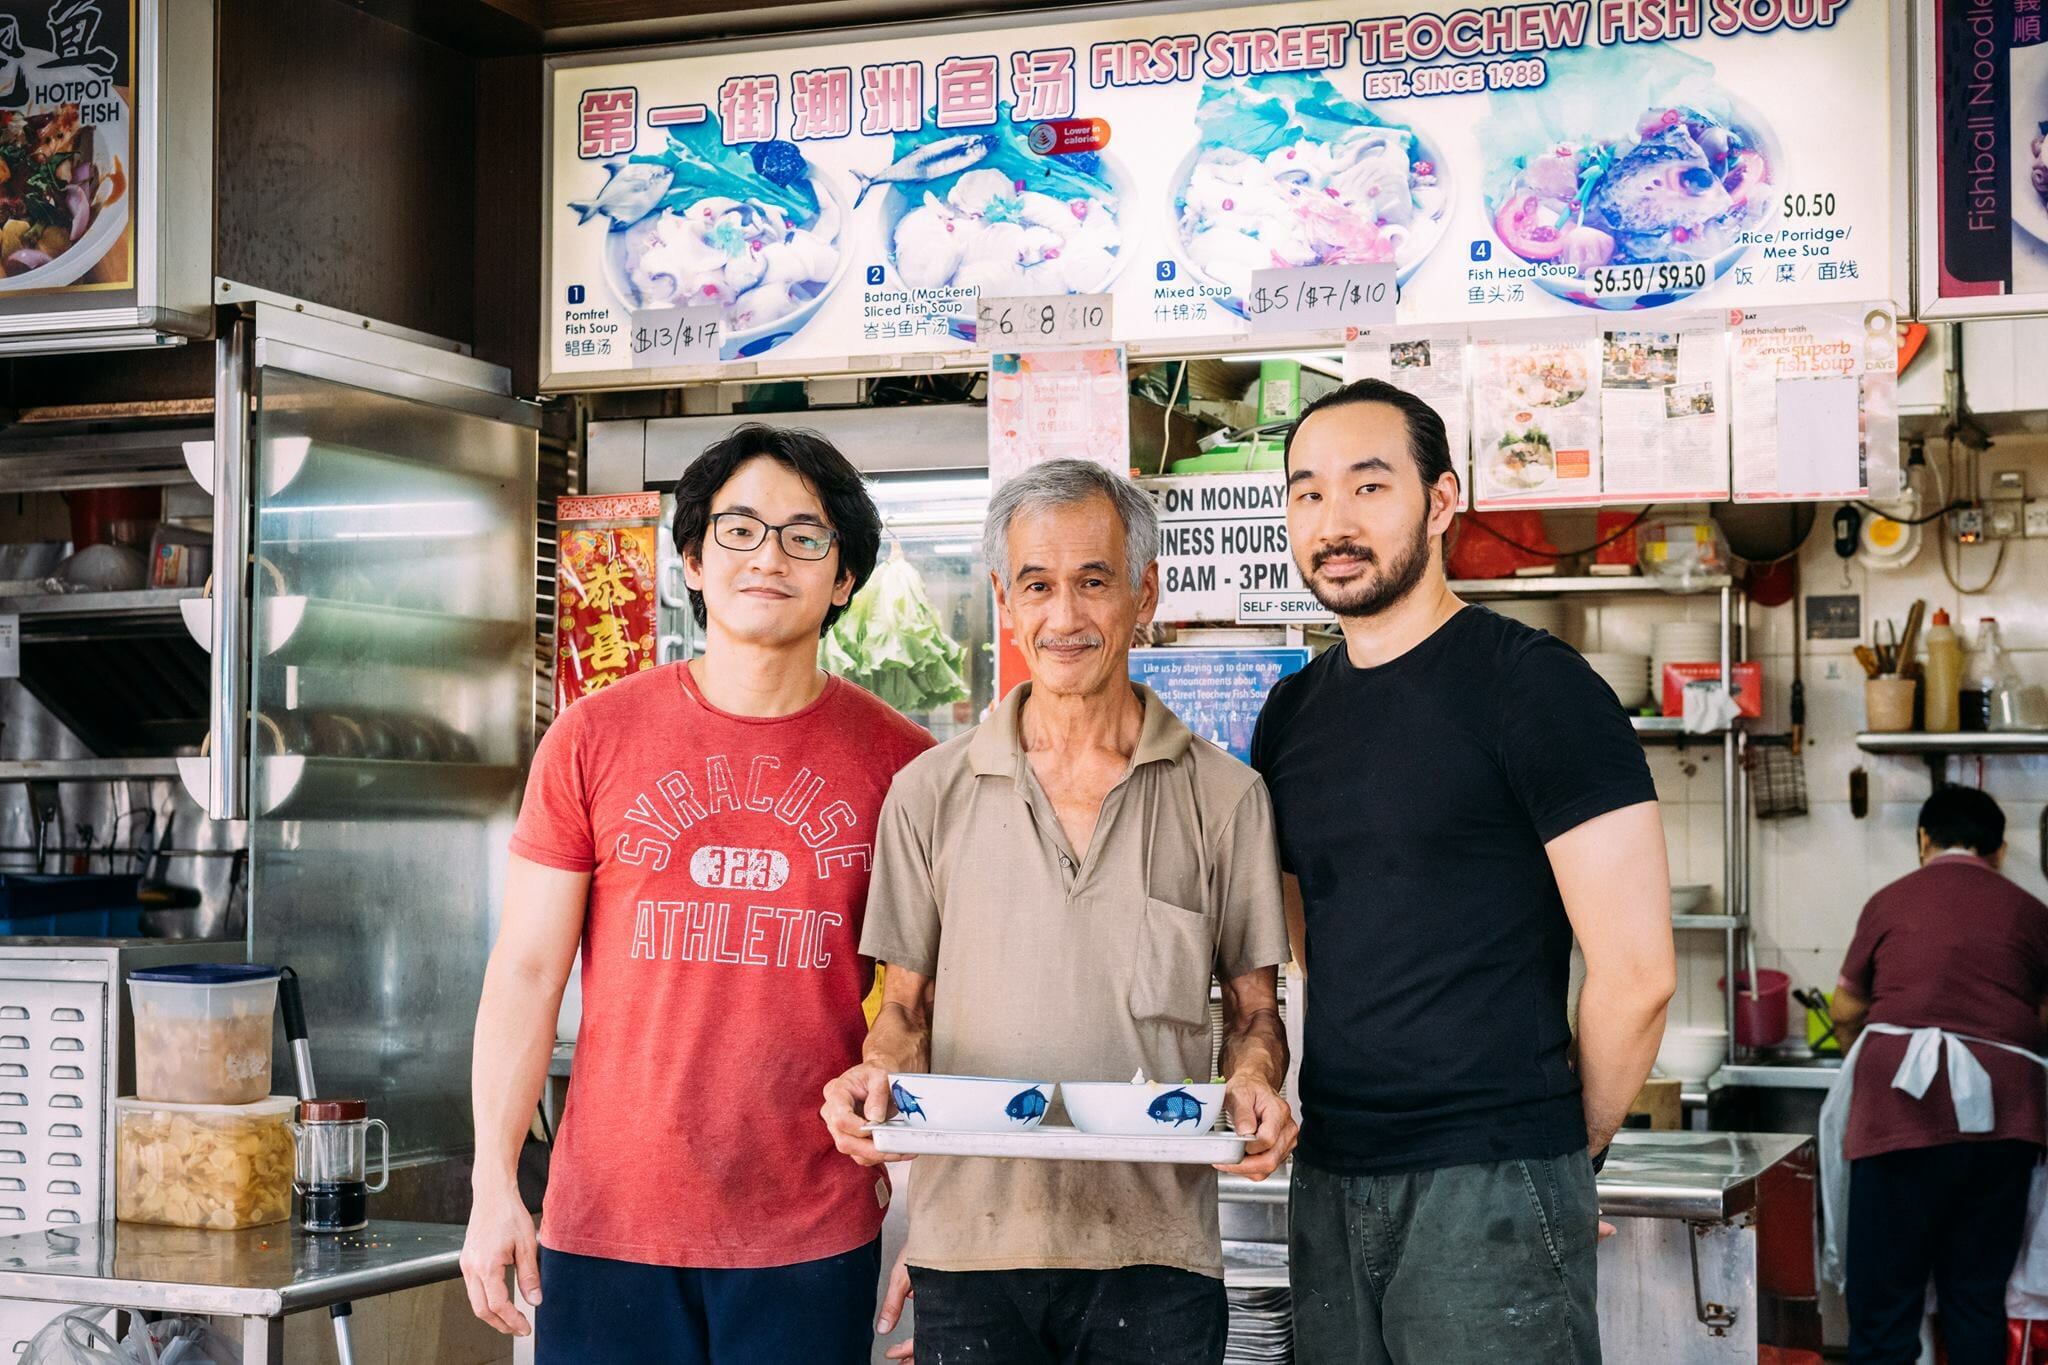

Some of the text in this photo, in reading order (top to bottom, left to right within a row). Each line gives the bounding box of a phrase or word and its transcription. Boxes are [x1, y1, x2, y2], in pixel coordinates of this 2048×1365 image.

[1091, 0, 1849, 88] FIRST STREET TEOCHEW FISH SOUP
[1364, 57, 1547, 100] EST. SINCE 1988
[35, 78, 113, 104] HOTPOT
[578, 47, 1075, 159] 第一街潮洲鱼汤
[81, 102, 120, 124] FISH
[1064, 125, 1100, 136] Lower in
[1064, 135, 1100, 145] calories
[1968, 117, 1996, 231] Fishball
[1783, 192, 1836, 219] $0.50
[1763, 244, 1830, 259] Mee Sua
[1468, 263, 1578, 280] Fish Head Soup
[864, 285, 981, 304] Batang (Mackerel)
[1154, 285, 1232, 299] Mixed Soup
[1467, 284, 1525, 304] 鱼头汤
[565, 309, 609, 321] Pomfret
[864, 302, 963, 317] Sliced Fish Soup
[1153, 303, 1208, 323] 什锦汤
[565, 322, 618, 336] Fish Soup
[1359, 329, 1371, 337] EAT
[1792, 339, 1851, 362] superb
[1811, 357, 1855, 375] soup
[1165, 488, 1194, 512] ON
[1161, 525, 1288, 556] INESS HOURS
[1166, 565, 1216, 592] 8AM
[1239, 563, 1288, 590] 3PM
[1243, 601, 1328, 612] SELF-SERVIC
[1143, 664, 1159, 673] Like
[1172, 663, 1182, 676] by
[1183, 663, 1212, 675] staying
[1213, 665, 1225, 675] up
[1226, 663, 1235, 672] to
[1236, 662, 1254, 672] date
[1255, 664, 1265, 672] on
[1266, 664, 1283, 674] any
[1168, 676, 1257, 686] announcements about
[1172, 689, 1196, 699] Street
[1197, 689, 1232, 699] Teochew
[1232, 689, 1249, 699] Fish
[616, 754, 873, 880] SYRACUSE
[631, 900, 843, 969] ATHLETIC
